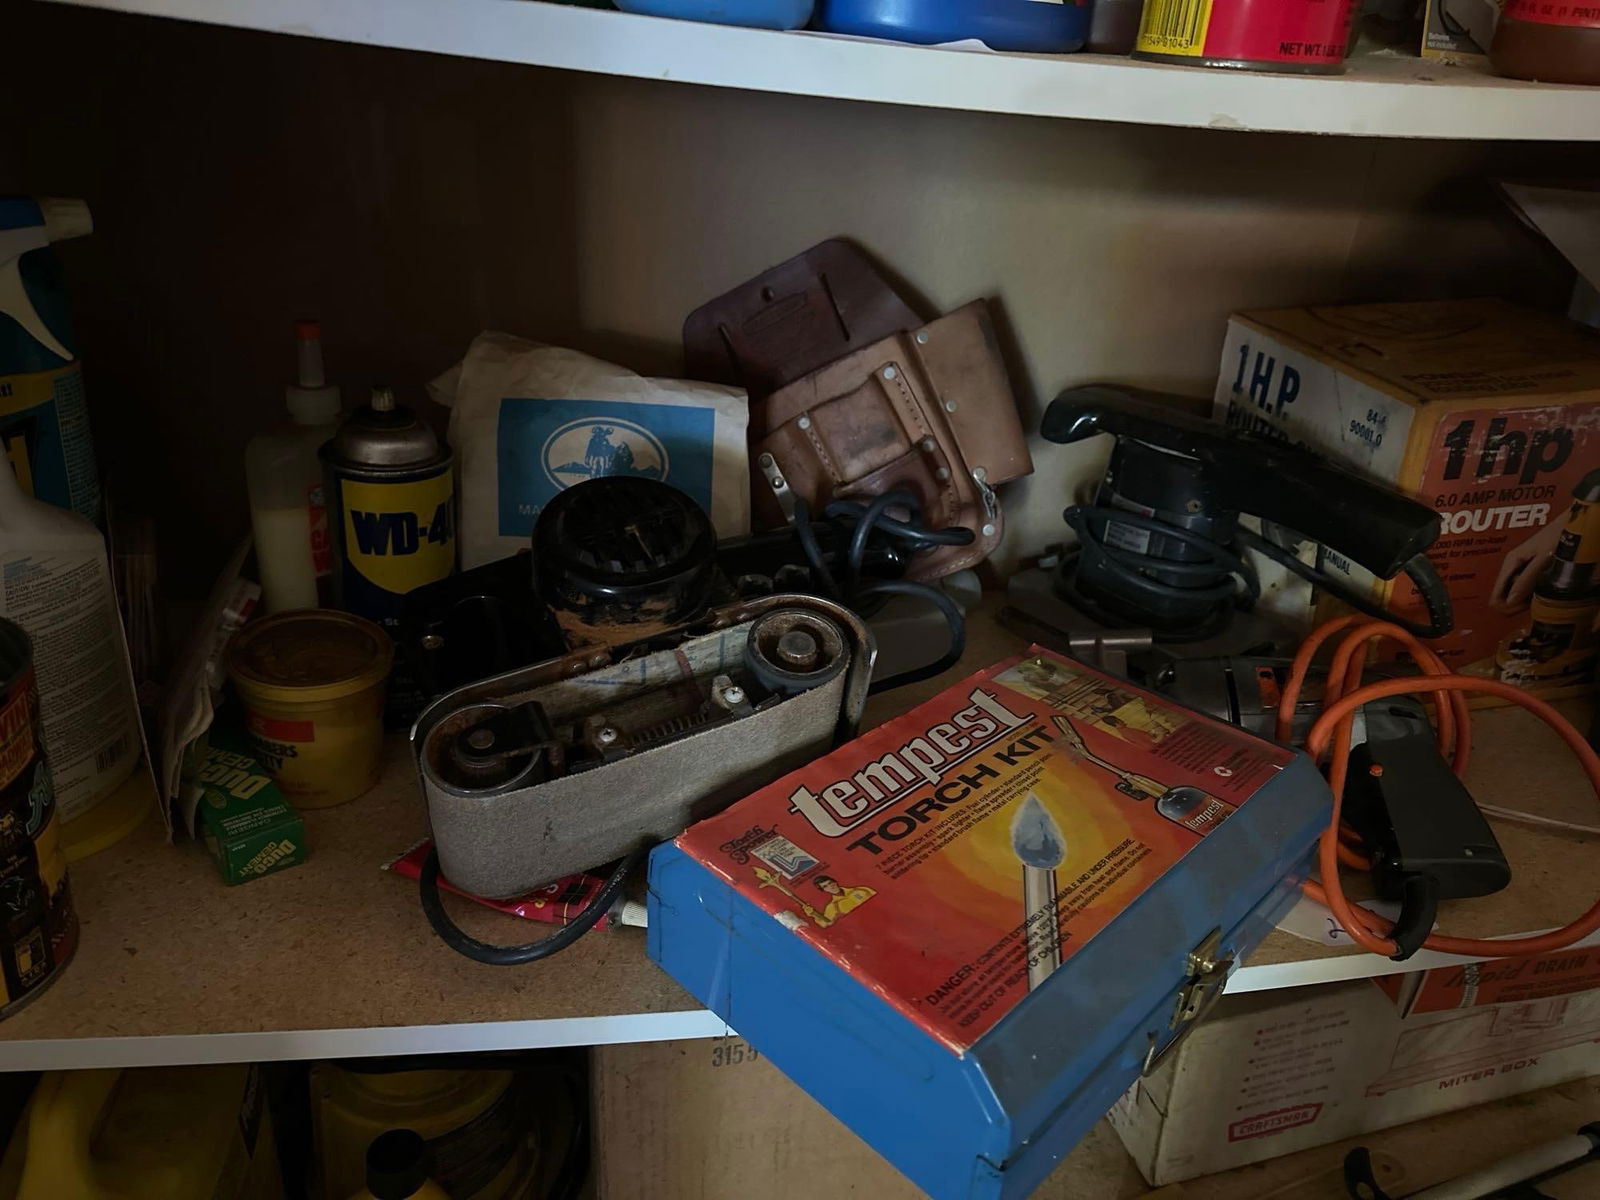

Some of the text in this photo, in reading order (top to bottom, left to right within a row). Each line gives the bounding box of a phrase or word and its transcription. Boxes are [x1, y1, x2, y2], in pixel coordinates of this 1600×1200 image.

[1279, 42, 1304, 57] NET
[1304, 43, 1323, 57] WT
[1444, 417, 1575, 485] 1hp
[1435, 485, 1557, 508] 6.0 AMP MOTOR
[351, 494, 454, 556] WD-4
[1440, 503, 1551, 535] ROUTER
[788, 687, 1037, 838] tempest
[847, 764, 1001, 855] TORCH
[993, 725, 1056, 767] KIT
[1184, 799, 1224, 830] tempest
[254, 838, 297, 875] DUCO
[1534, 954, 1589, 975] DRAIN
[923, 960, 981, 1006] DANGER:
[1438, 1056, 1541, 1090] MITER BOX
